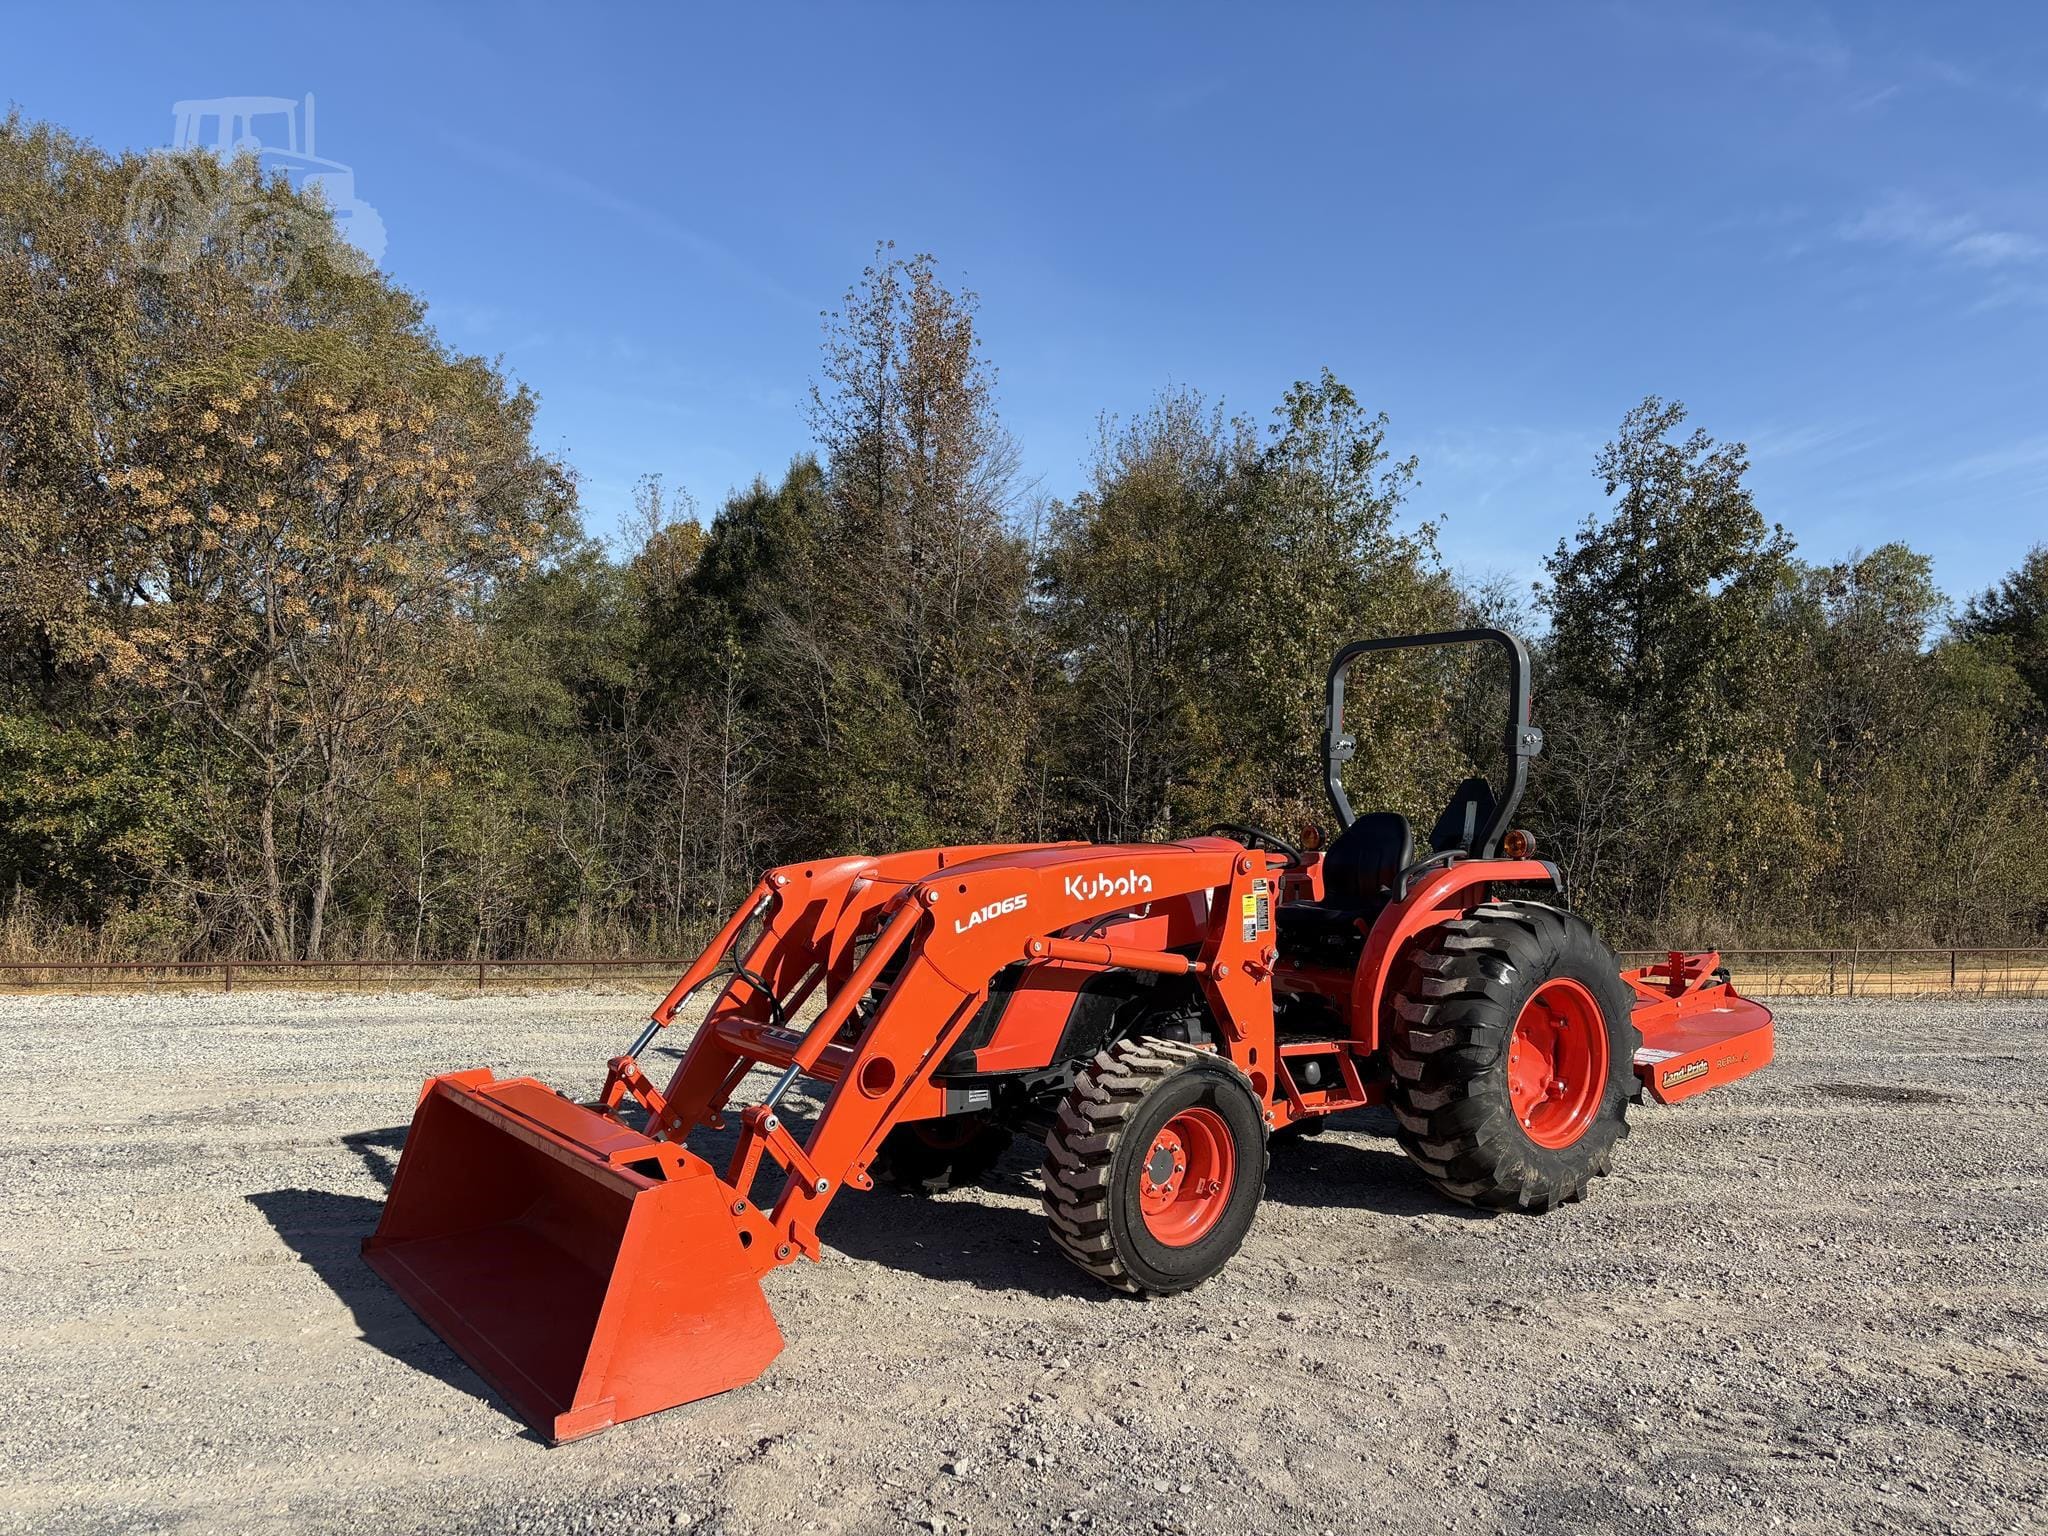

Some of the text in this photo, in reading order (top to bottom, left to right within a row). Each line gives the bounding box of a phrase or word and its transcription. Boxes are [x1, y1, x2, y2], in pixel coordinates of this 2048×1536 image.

[1065, 869, 1152, 901] Kubota
[955, 893, 1028, 934] LA1065
[1663, 1066, 1685, 1082] Land
[1686, 1060, 1708, 1074] Pride
